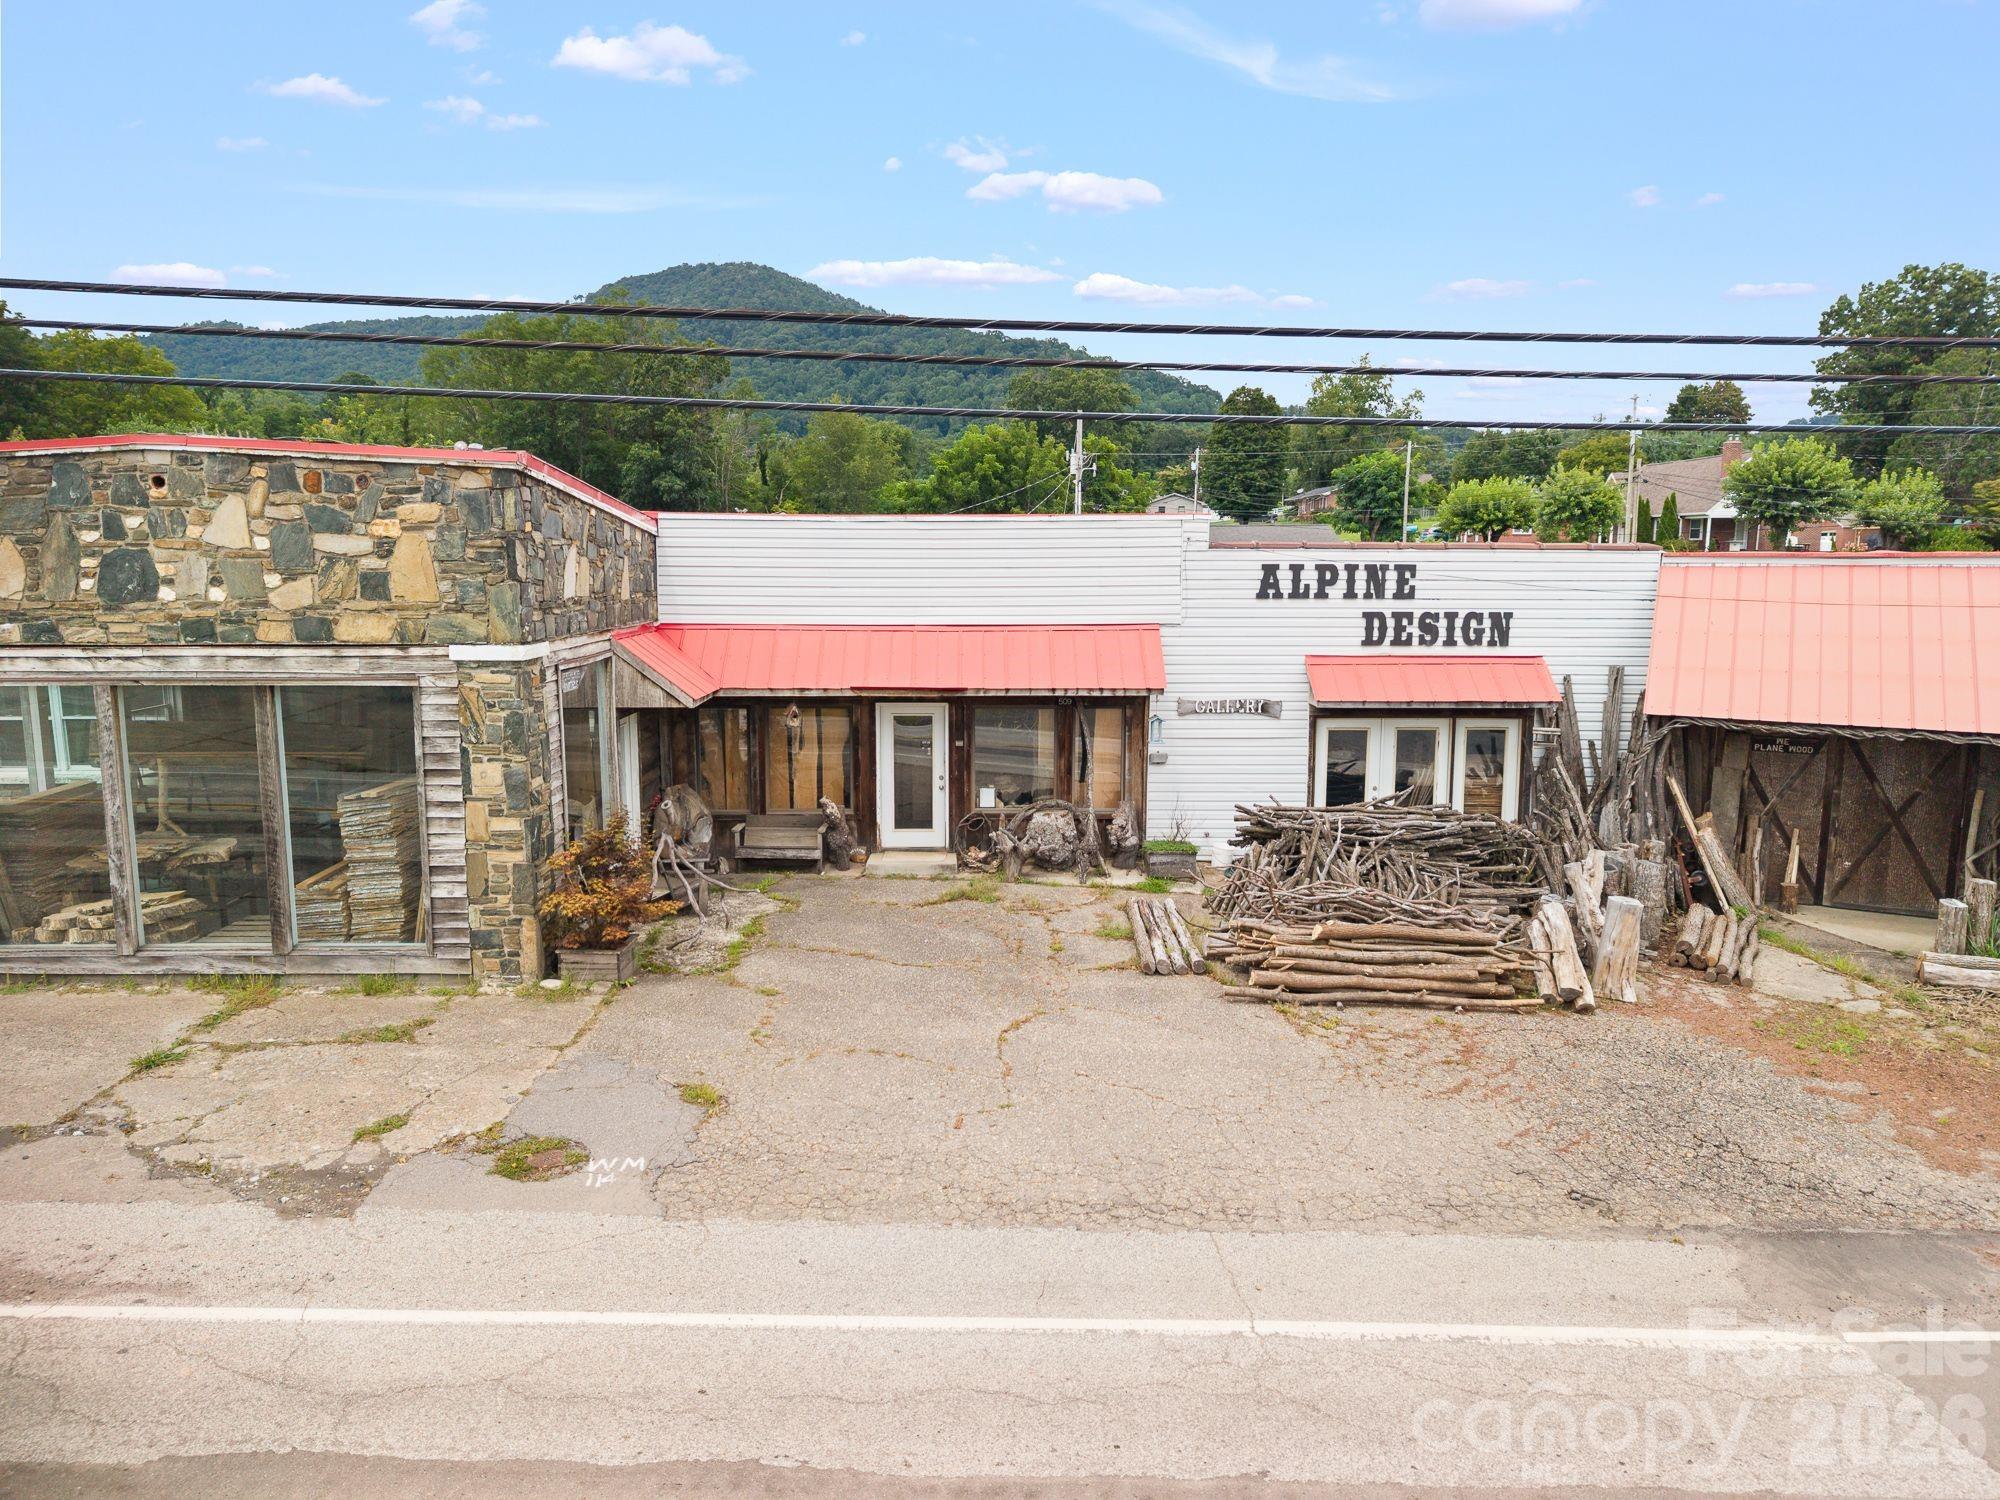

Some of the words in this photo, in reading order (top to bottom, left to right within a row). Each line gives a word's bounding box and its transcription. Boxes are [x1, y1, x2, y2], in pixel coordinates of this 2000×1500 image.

[1256, 563, 1417, 600] ALPINE
[1361, 611, 1514, 647] DESIGN
[1754, 743, 1784, 752] PLANE
[1788, 745, 1814, 754] WOOD
